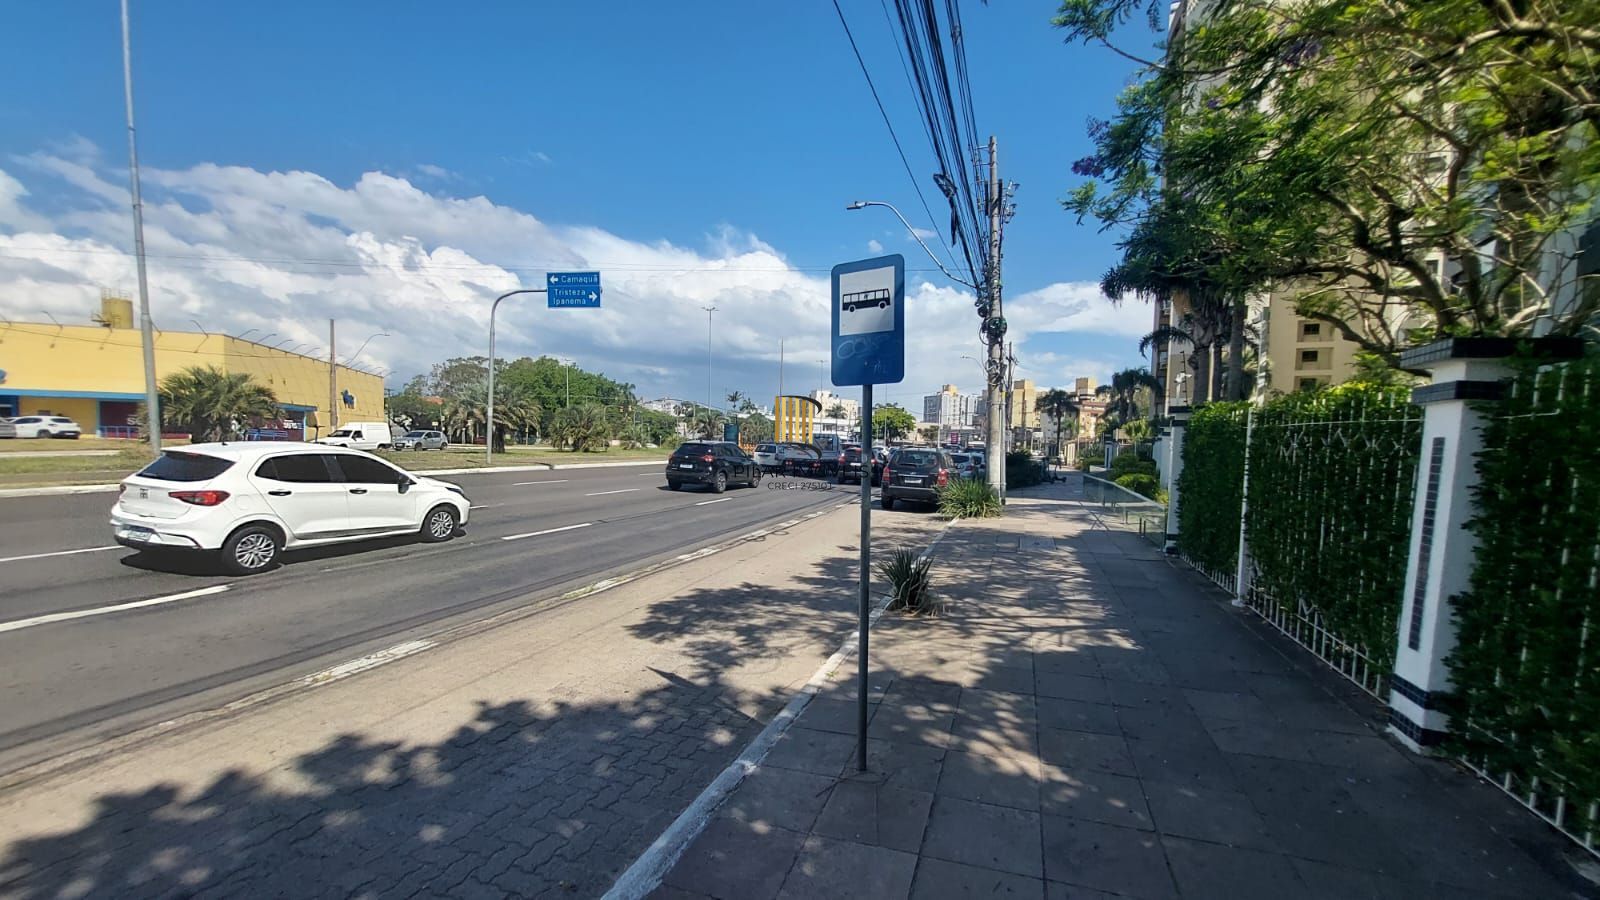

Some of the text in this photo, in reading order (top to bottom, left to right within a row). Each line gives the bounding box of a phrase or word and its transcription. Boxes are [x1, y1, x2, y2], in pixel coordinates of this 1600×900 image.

[561, 274, 598, 284] Camaquã
[555, 288, 586, 296] Tristeza
[553, 298, 587, 306] Ipanema
